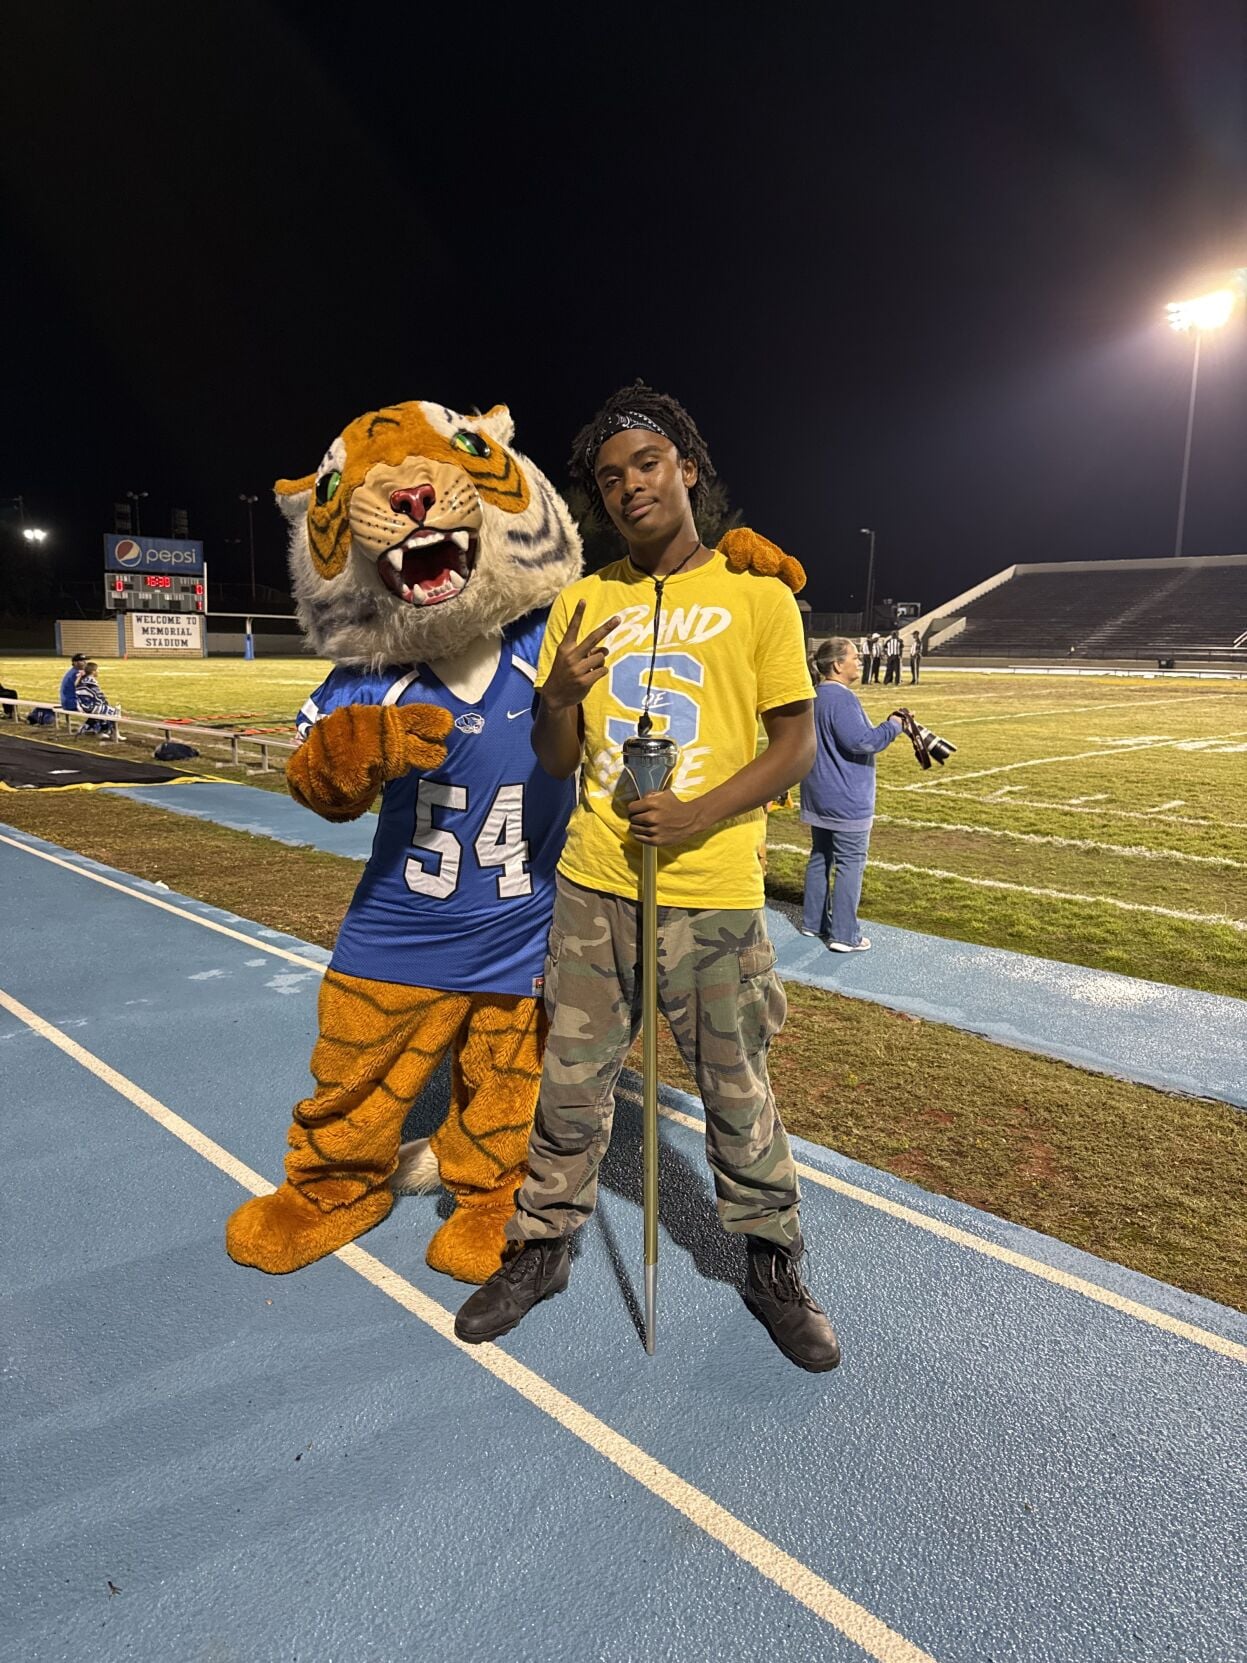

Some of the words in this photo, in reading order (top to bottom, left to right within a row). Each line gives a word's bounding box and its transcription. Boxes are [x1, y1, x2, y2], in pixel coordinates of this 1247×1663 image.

[146, 549, 196, 565] pepsi
[135, 615, 182, 625] WELCOME
[186, 616, 197, 625] TO
[141, 626, 192, 636] MEMORIAL
[598, 604, 732, 656] BAND
[145, 638, 188, 647] STADIUM
[604, 652, 704, 749] S
[641, 691, 666, 706] OF
[404, 778, 534, 900] 54
